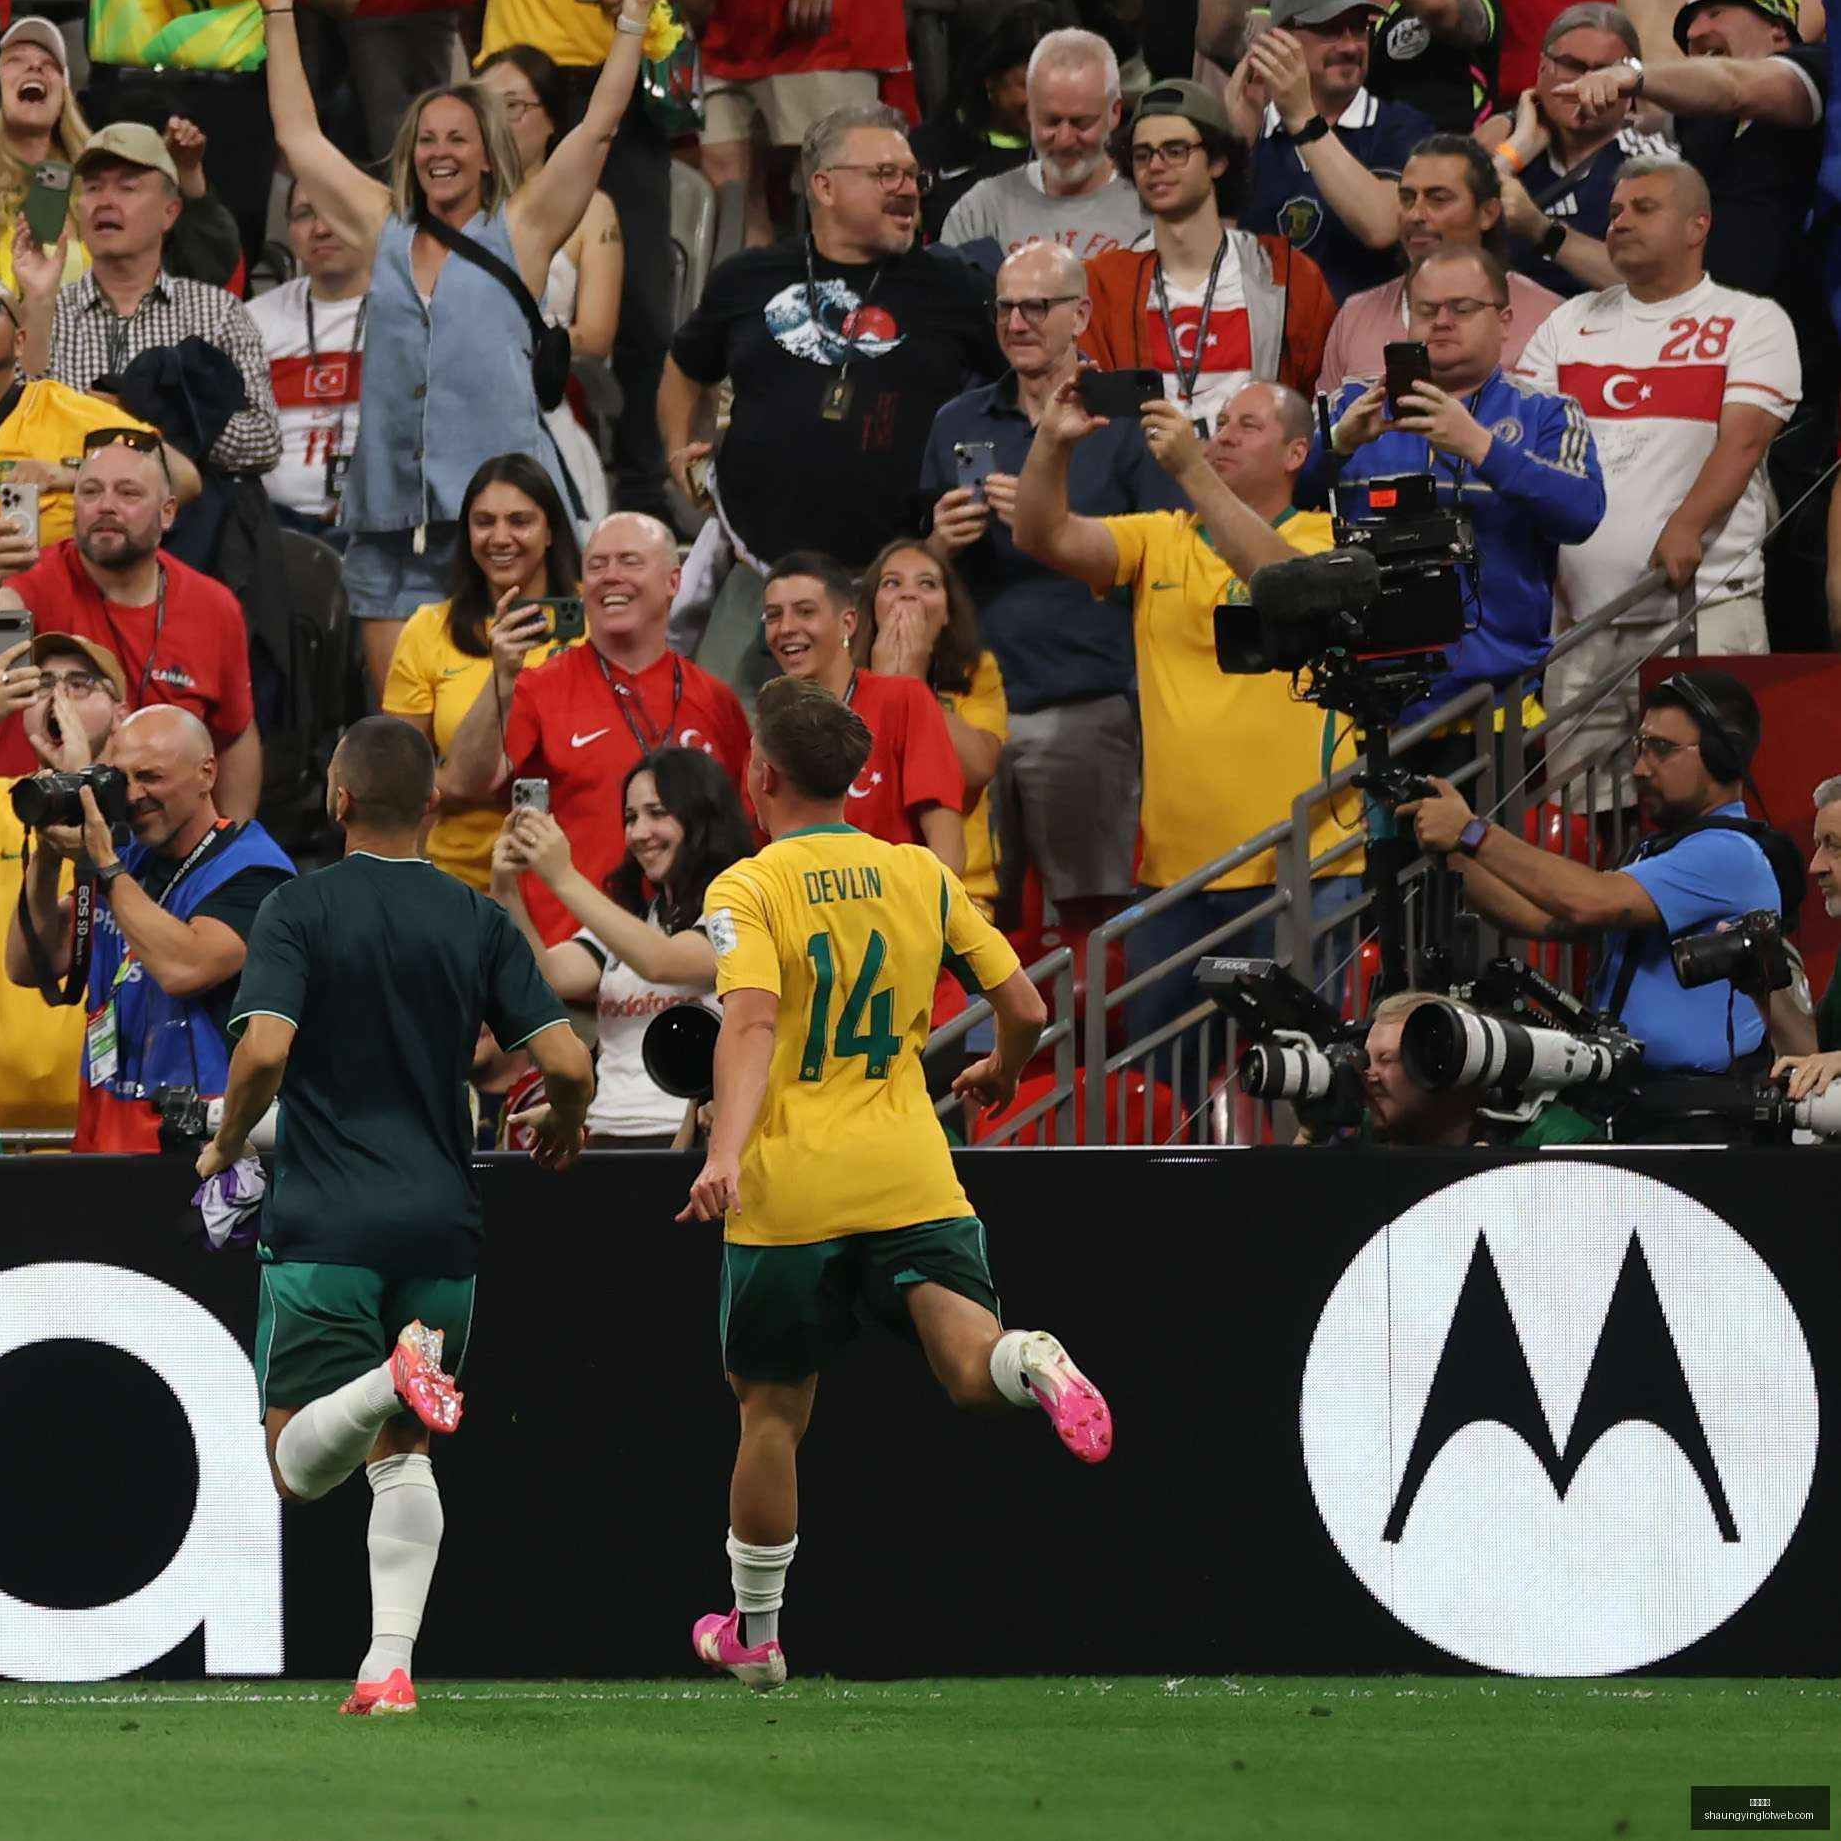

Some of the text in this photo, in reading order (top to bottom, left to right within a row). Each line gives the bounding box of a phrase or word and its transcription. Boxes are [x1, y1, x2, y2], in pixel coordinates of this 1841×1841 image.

[1660, 316, 1735, 362] 28
[802, 864, 883, 906] DEVLIN
[797, 930, 903, 1082] 14
